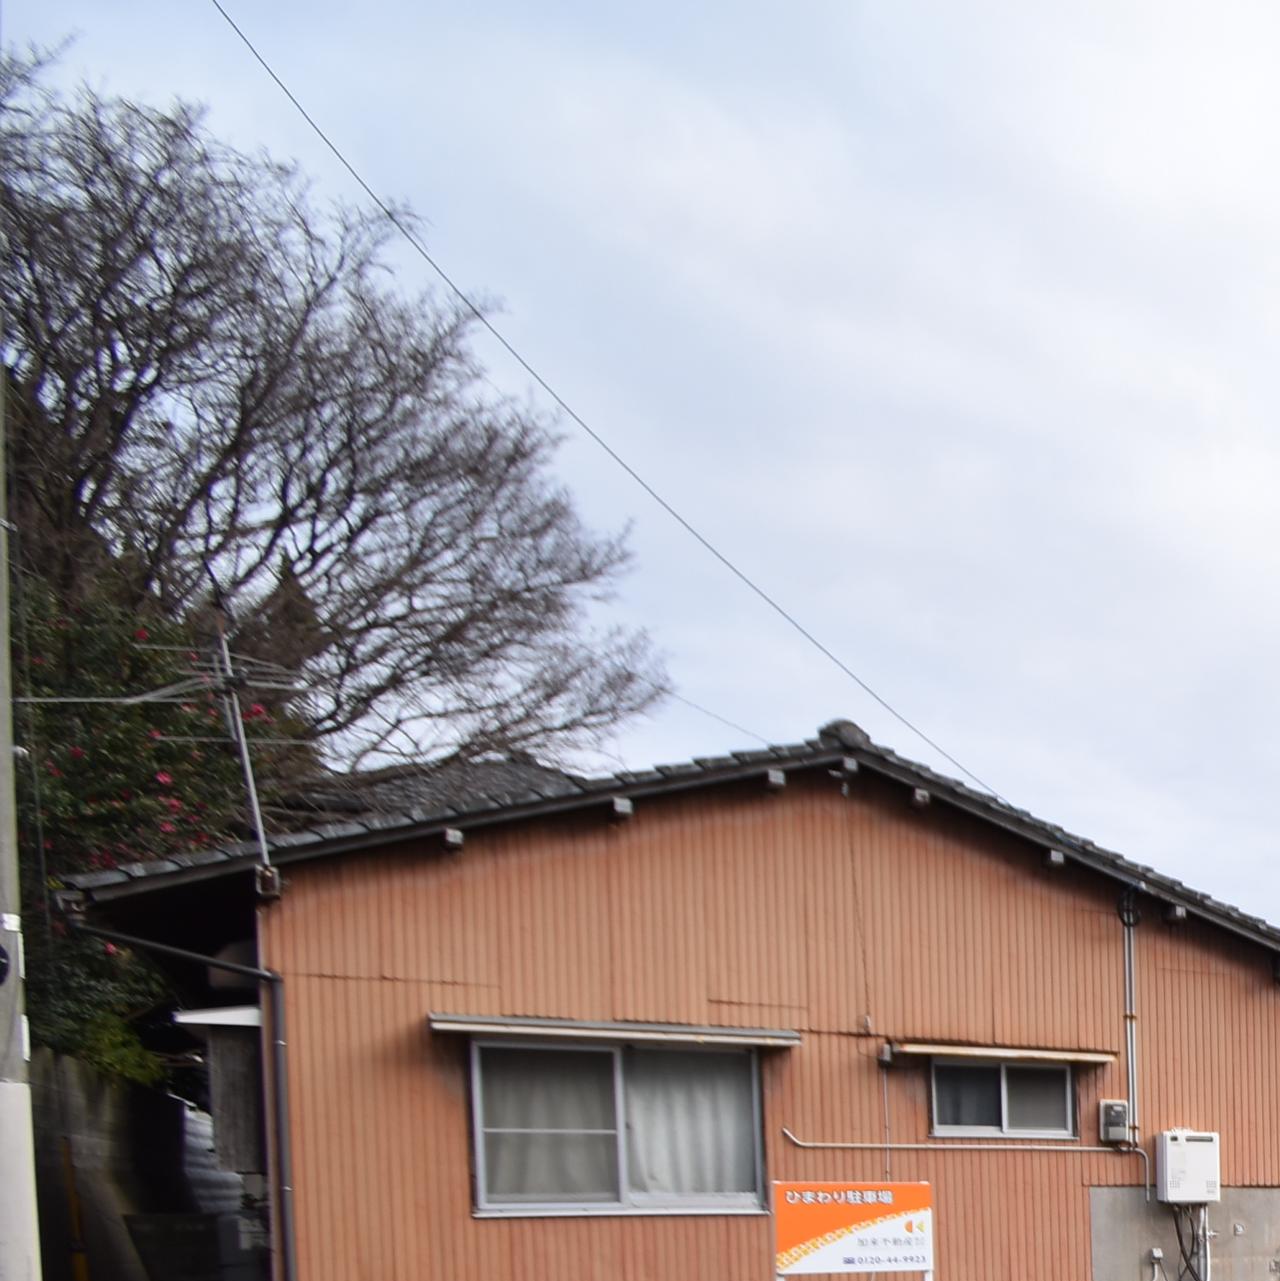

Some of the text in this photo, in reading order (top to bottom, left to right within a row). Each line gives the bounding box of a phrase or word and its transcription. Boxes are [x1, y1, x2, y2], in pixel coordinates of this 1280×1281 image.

[785, 1190, 893, 1204] ひまわり駐車場
